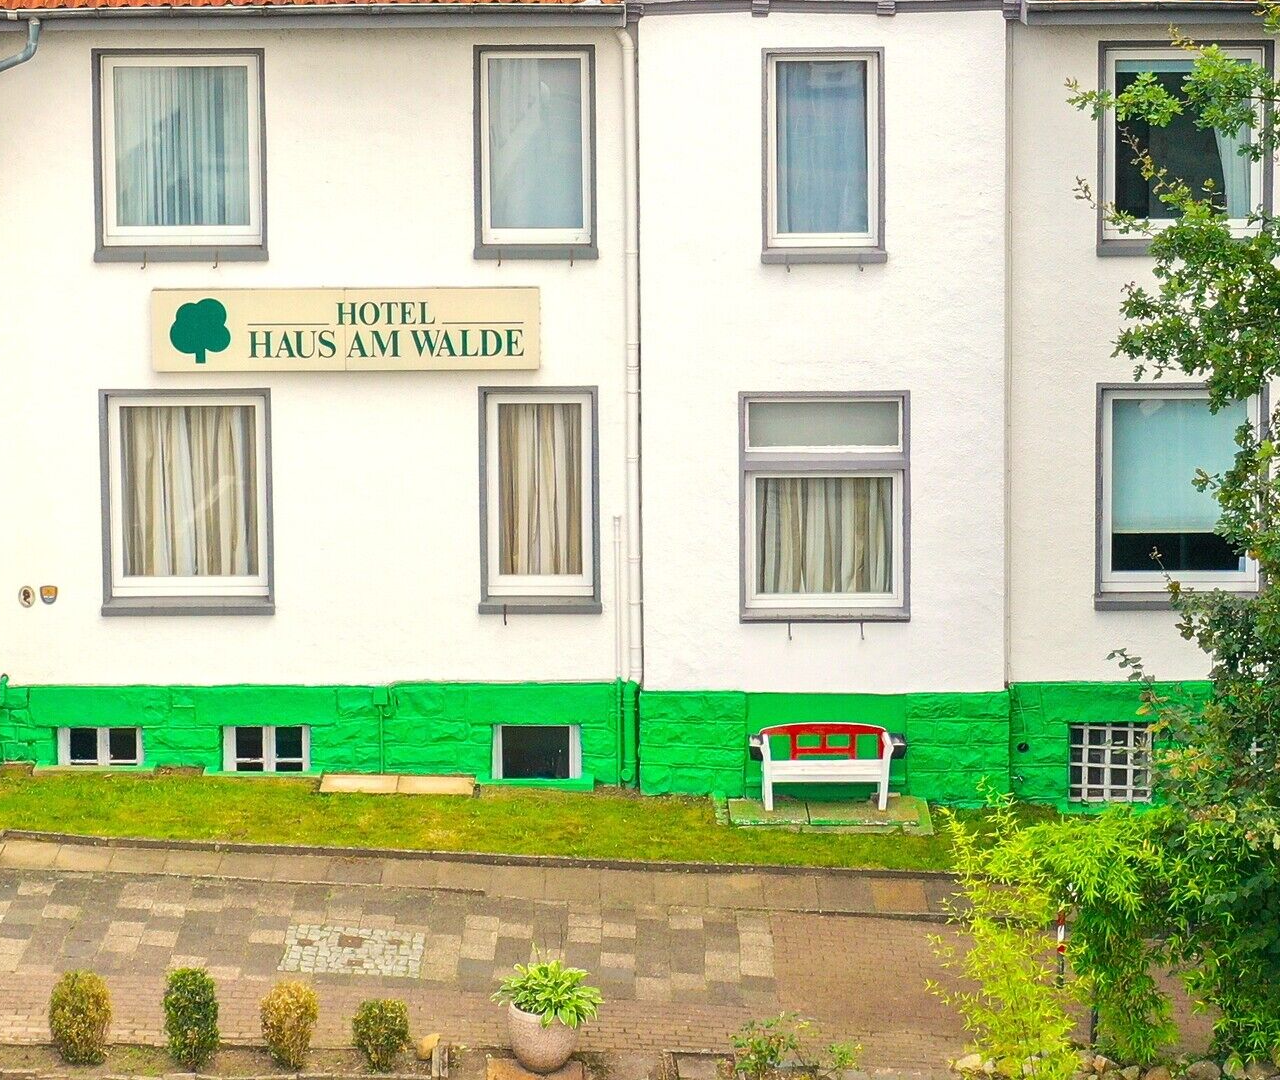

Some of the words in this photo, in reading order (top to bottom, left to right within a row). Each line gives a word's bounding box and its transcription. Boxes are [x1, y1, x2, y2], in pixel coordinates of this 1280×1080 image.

[335, 301, 436, 326] HOTEL
[247, 330, 337, 360] HAUS
[345, 330, 400, 359] AM
[411, 328, 525, 358] WALDE
